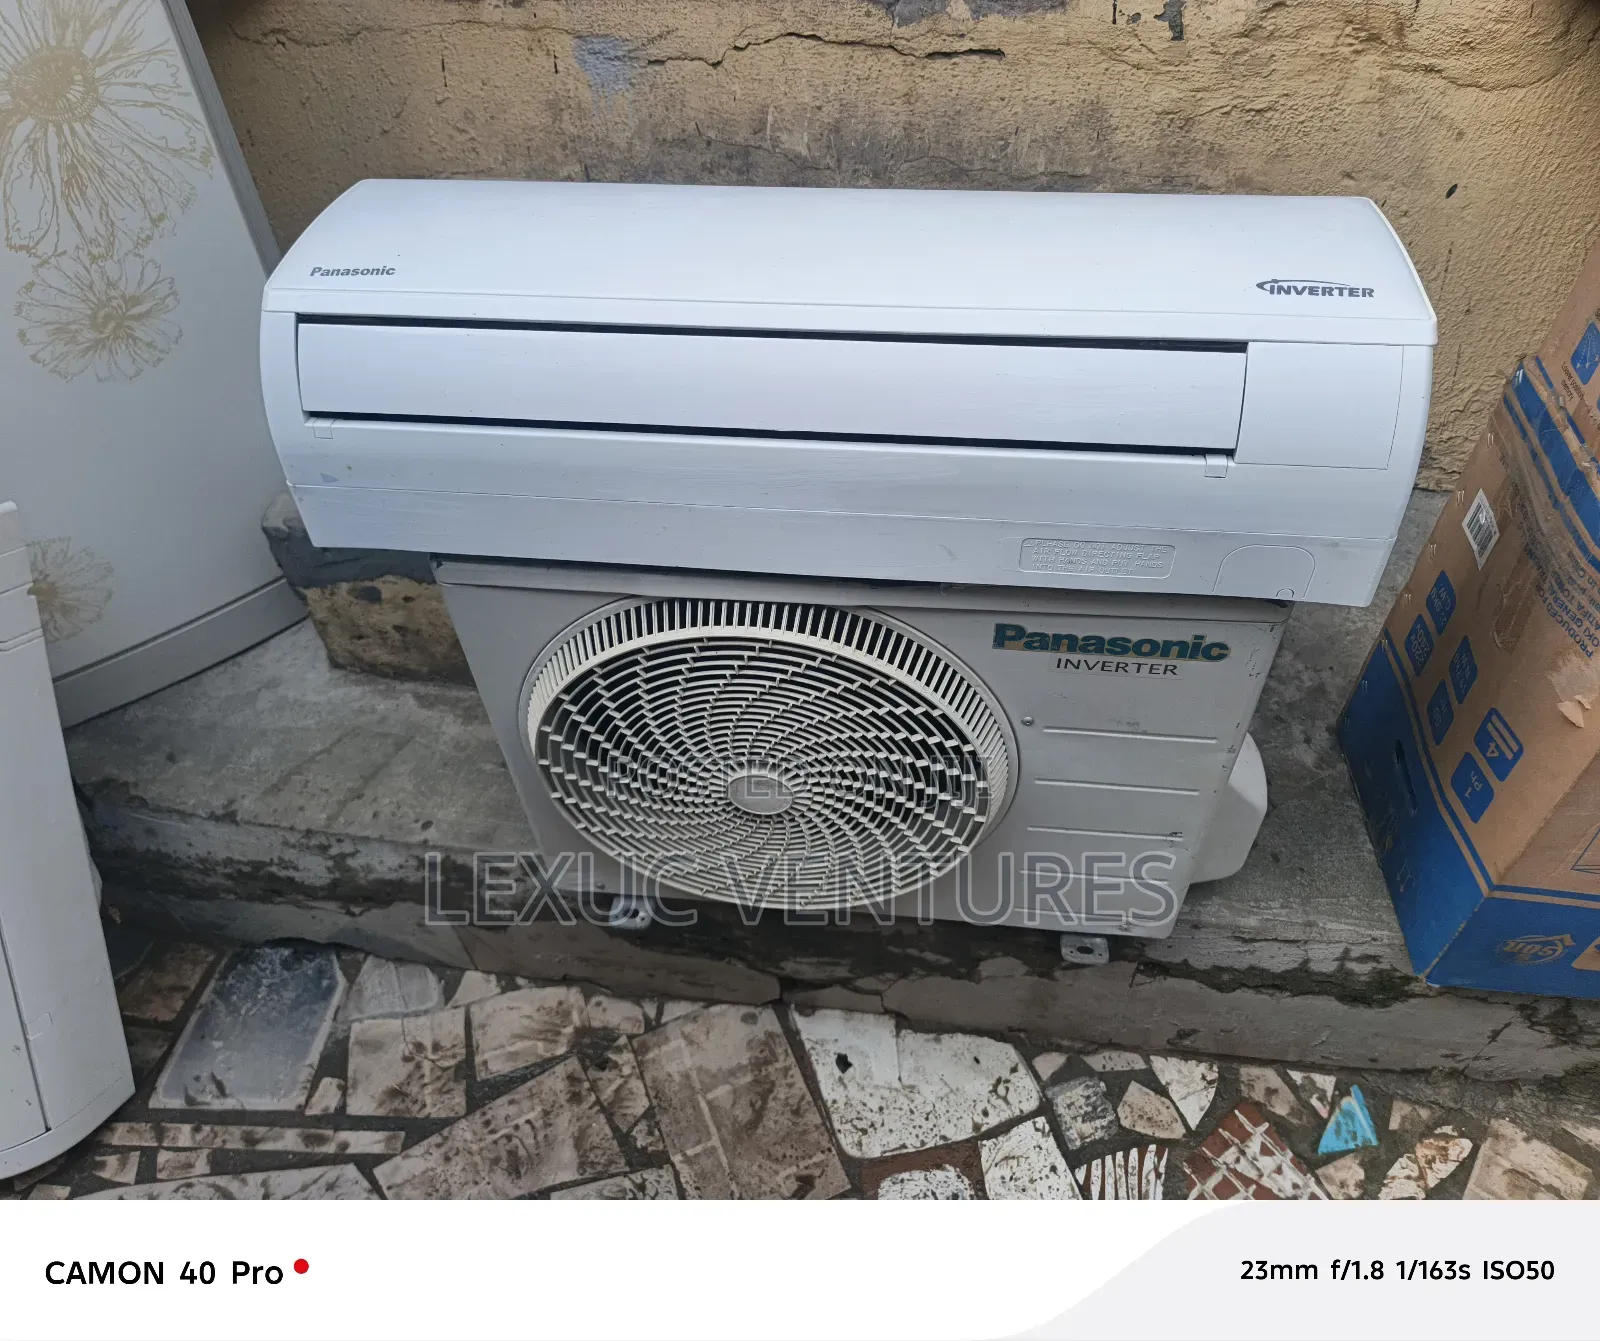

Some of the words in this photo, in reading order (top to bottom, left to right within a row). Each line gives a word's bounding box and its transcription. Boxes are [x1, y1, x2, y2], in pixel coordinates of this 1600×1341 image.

[310, 265, 396, 278] Panasonic
[1268, 282, 1375, 298] INVERTER
[1032, 547, 1051, 555] AIR
[1054, 548, 1079, 556] FLOW
[1081, 550, 1133, 559] DIRECTING
[1135, 552, 1161, 560] FLAP
[1035, 540, 1070, 549] PLEASE
[1073, 541, 1086, 549] DO
[1089, 542, 1107, 550] NOT
[1111, 543, 1147, 552] ADJUST
[1151, 545, 1169, 553] THE
[1031, 555, 1055, 563] WITH
[1058, 556, 1088, 565] HANDS
[1091, 558, 1109, 566] AND
[1111, 559, 1129, 567] PUT
[1134, 560, 1164, 569] HANDS
[1031, 563, 1053, 571] INTO
[1056, 564, 1075, 572] THE
[1078, 565, 1096, 573] AIR
[1098, 566, 1135, 575] OUTLET
[1548, 580, 1583, 628] GENERAL
[1546, 602, 1594, 658] PRODUCED
[1583, 627, 1600, 648] OKI
[992, 623, 1230, 661] Panasonic
[1056, 657, 1178, 676] INVERTER
[1486, 741, 1499, 758] 4
